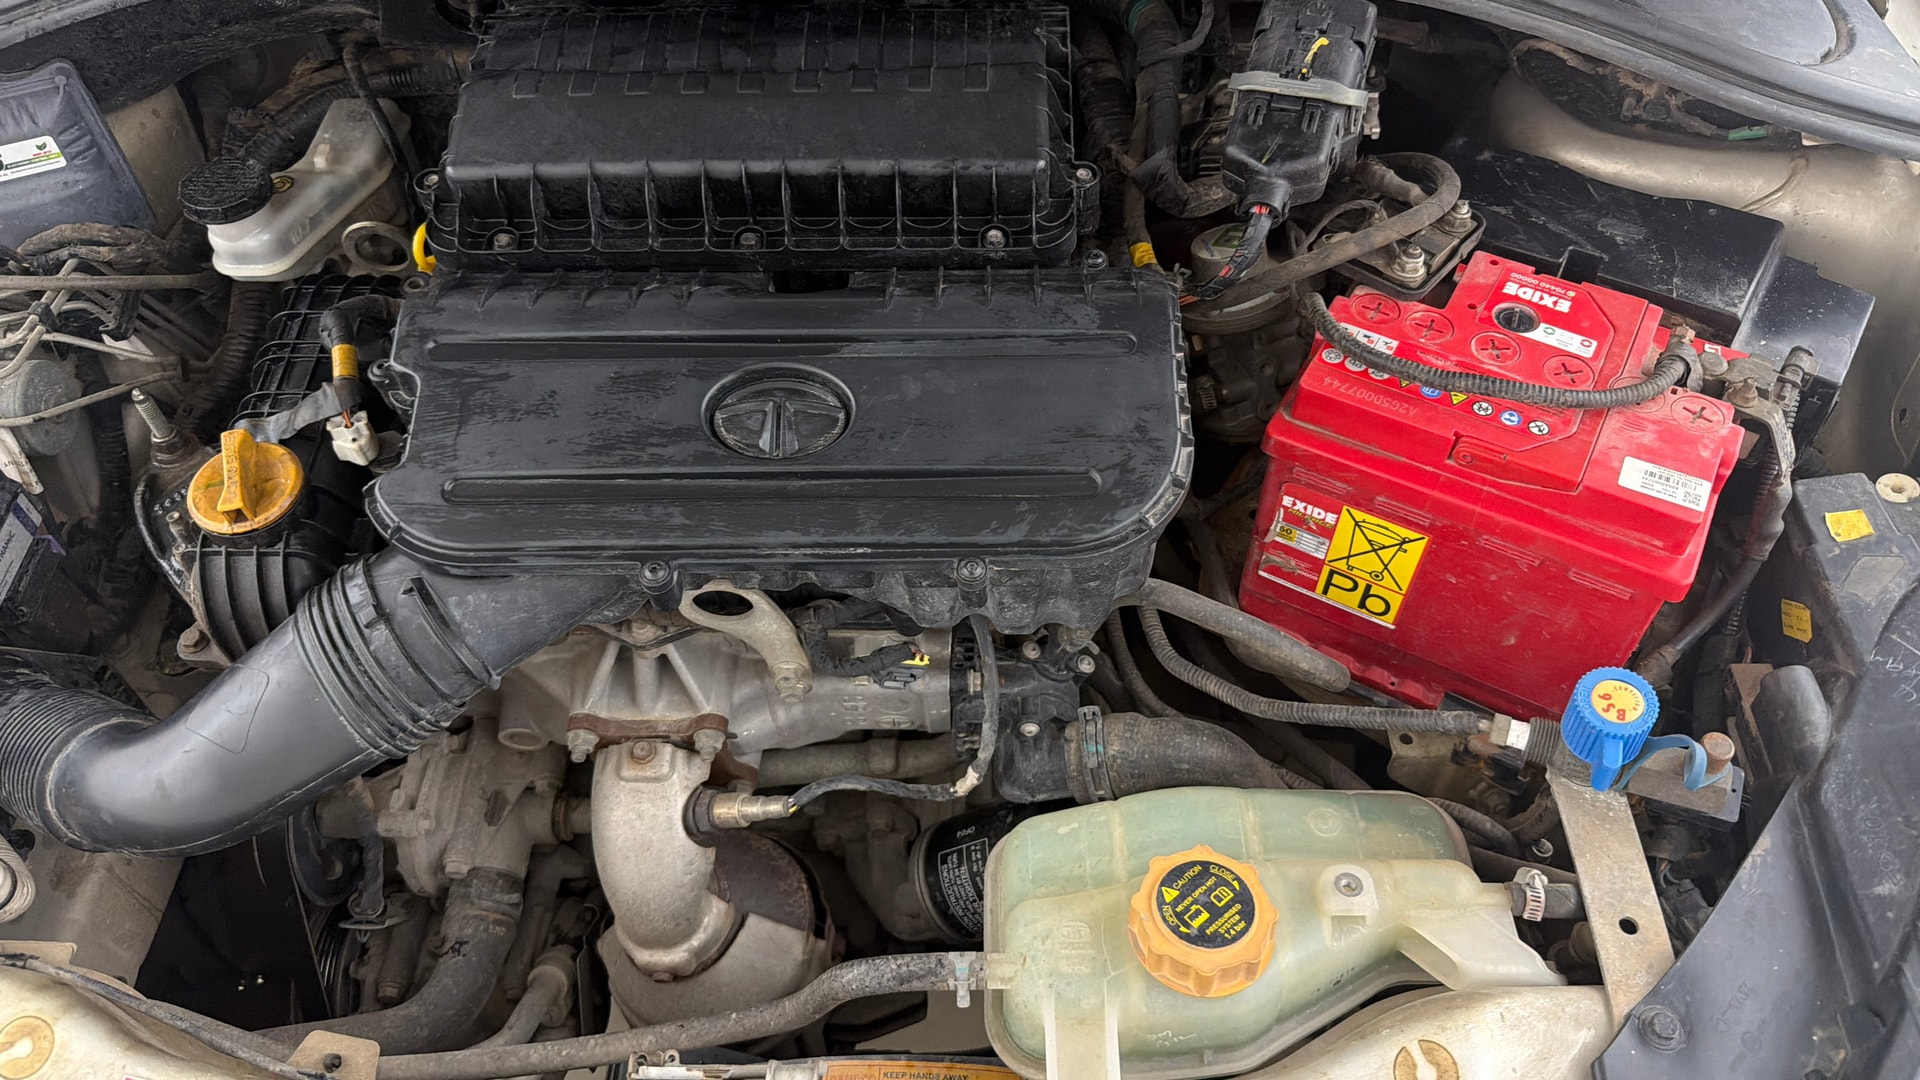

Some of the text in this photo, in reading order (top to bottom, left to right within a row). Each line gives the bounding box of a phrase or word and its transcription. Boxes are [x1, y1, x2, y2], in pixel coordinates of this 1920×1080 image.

[1510, 272, 1539, 285] 00000
[1501, 281, 1572, 313] EXIDE
[1282, 495, 1338, 525] EXIDE
[1321, 568, 1391, 617] Pb
[1643, 691, 1657, 721] CLOSE
[1173, 864, 1203, 889] CAUTION
[1209, 864, 1236, 881] CLOSE
[941, 863, 963, 916] INSTRUCTIONS
[1175, 876, 1217, 912] NEVER OPEN HOT
[1162, 905, 1176, 925] OPEN
[1205, 903, 1242, 935] PRESSURISED
[1218, 914, 1241, 934] SYSTEM
[1224, 920, 1246, 939] 1.4 bar
[909, 1072, 940, 1080] HANDS
